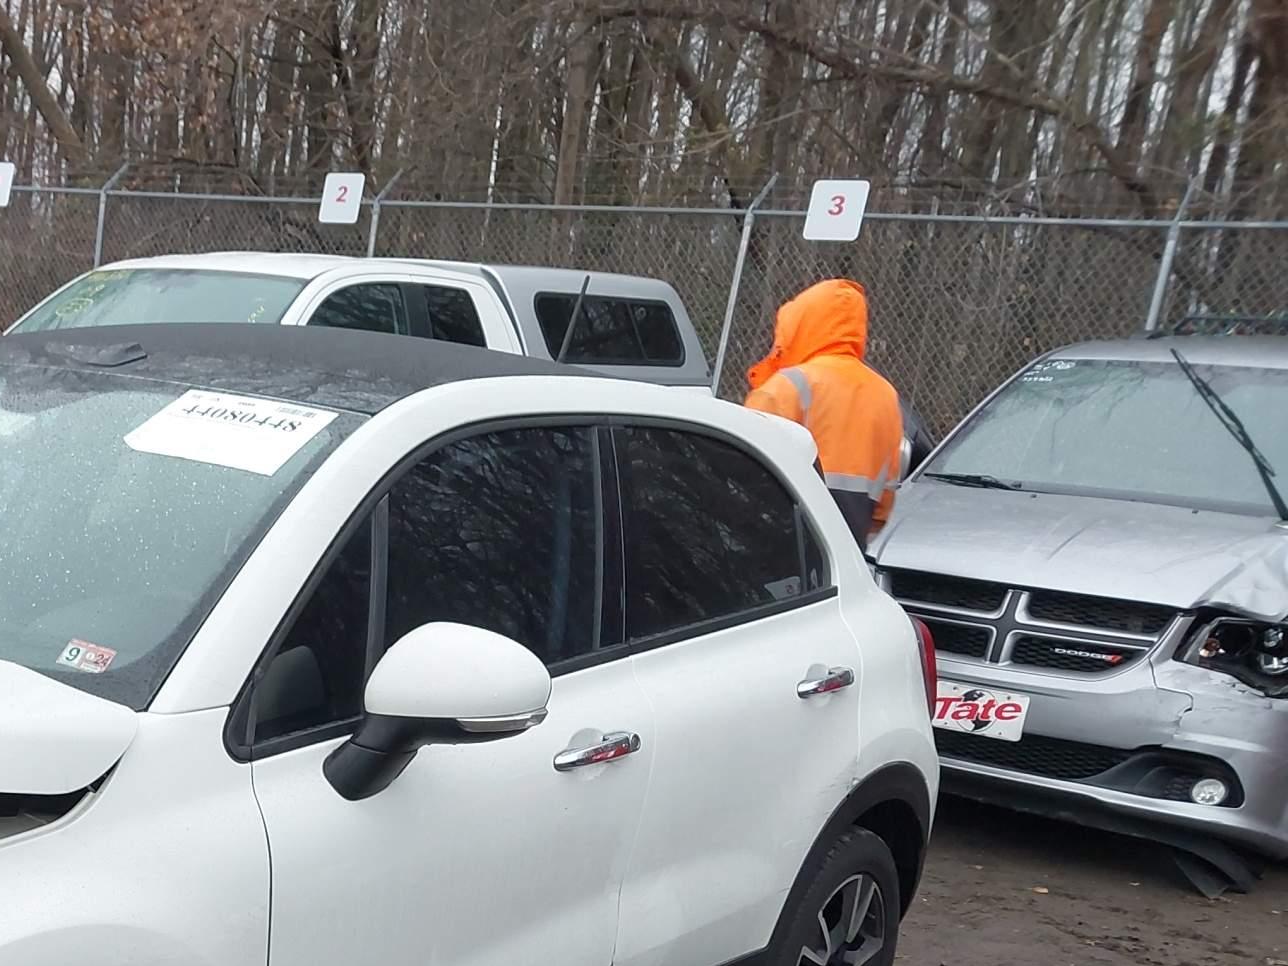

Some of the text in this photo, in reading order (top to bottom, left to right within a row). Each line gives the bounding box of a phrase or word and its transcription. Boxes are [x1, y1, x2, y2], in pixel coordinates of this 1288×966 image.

[336, 185, 348, 202] 2
[828, 195, 845, 216] 3
[182, 404, 302, 432] 44080448
[66, 647, 81, 662] 9
[1054, 647, 1114, 661] DODGE
[935, 697, 1022, 720] Tate
